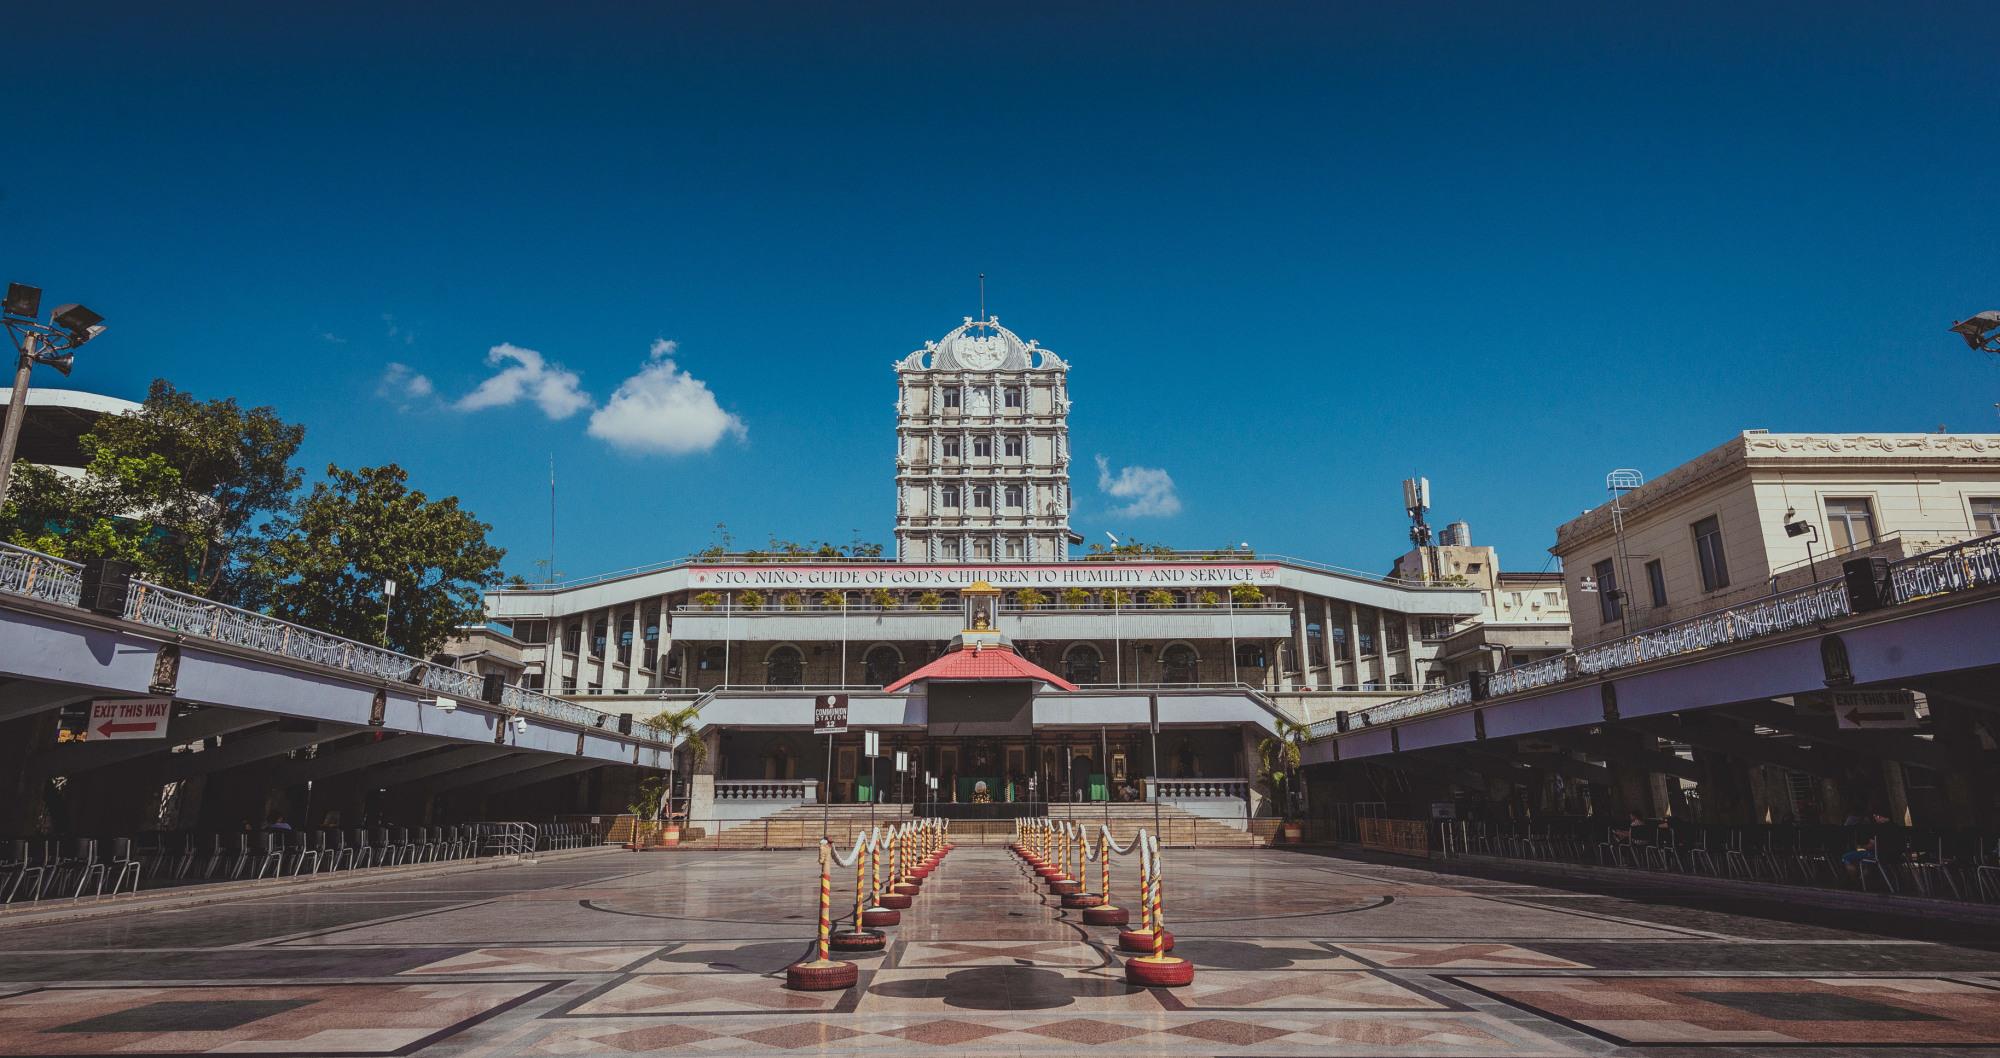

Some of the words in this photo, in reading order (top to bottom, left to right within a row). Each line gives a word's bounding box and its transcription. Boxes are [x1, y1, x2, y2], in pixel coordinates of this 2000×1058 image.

[715, 571, 749, 584] STO.
[755, 568, 803, 584] NIÑO:
[809, 570, 860, 583] GUIDE
[865, 570, 887, 583] OF
[891, 570, 943, 583] GOD'S
[947, 570, 1029, 583] CHILDREN
[1034, 570, 1057, 582] TO
[1063, 570, 1143, 582] HUMILITY
[1148, 569, 1185, 582] AND
[1190, 569, 1254, 581] SERVICE
[94, 705, 118, 718] EXIT
[120, 704, 143, 717] THIS
[145, 704, 168, 717] WAY
[815, 708, 847, 716] COMMUNION
